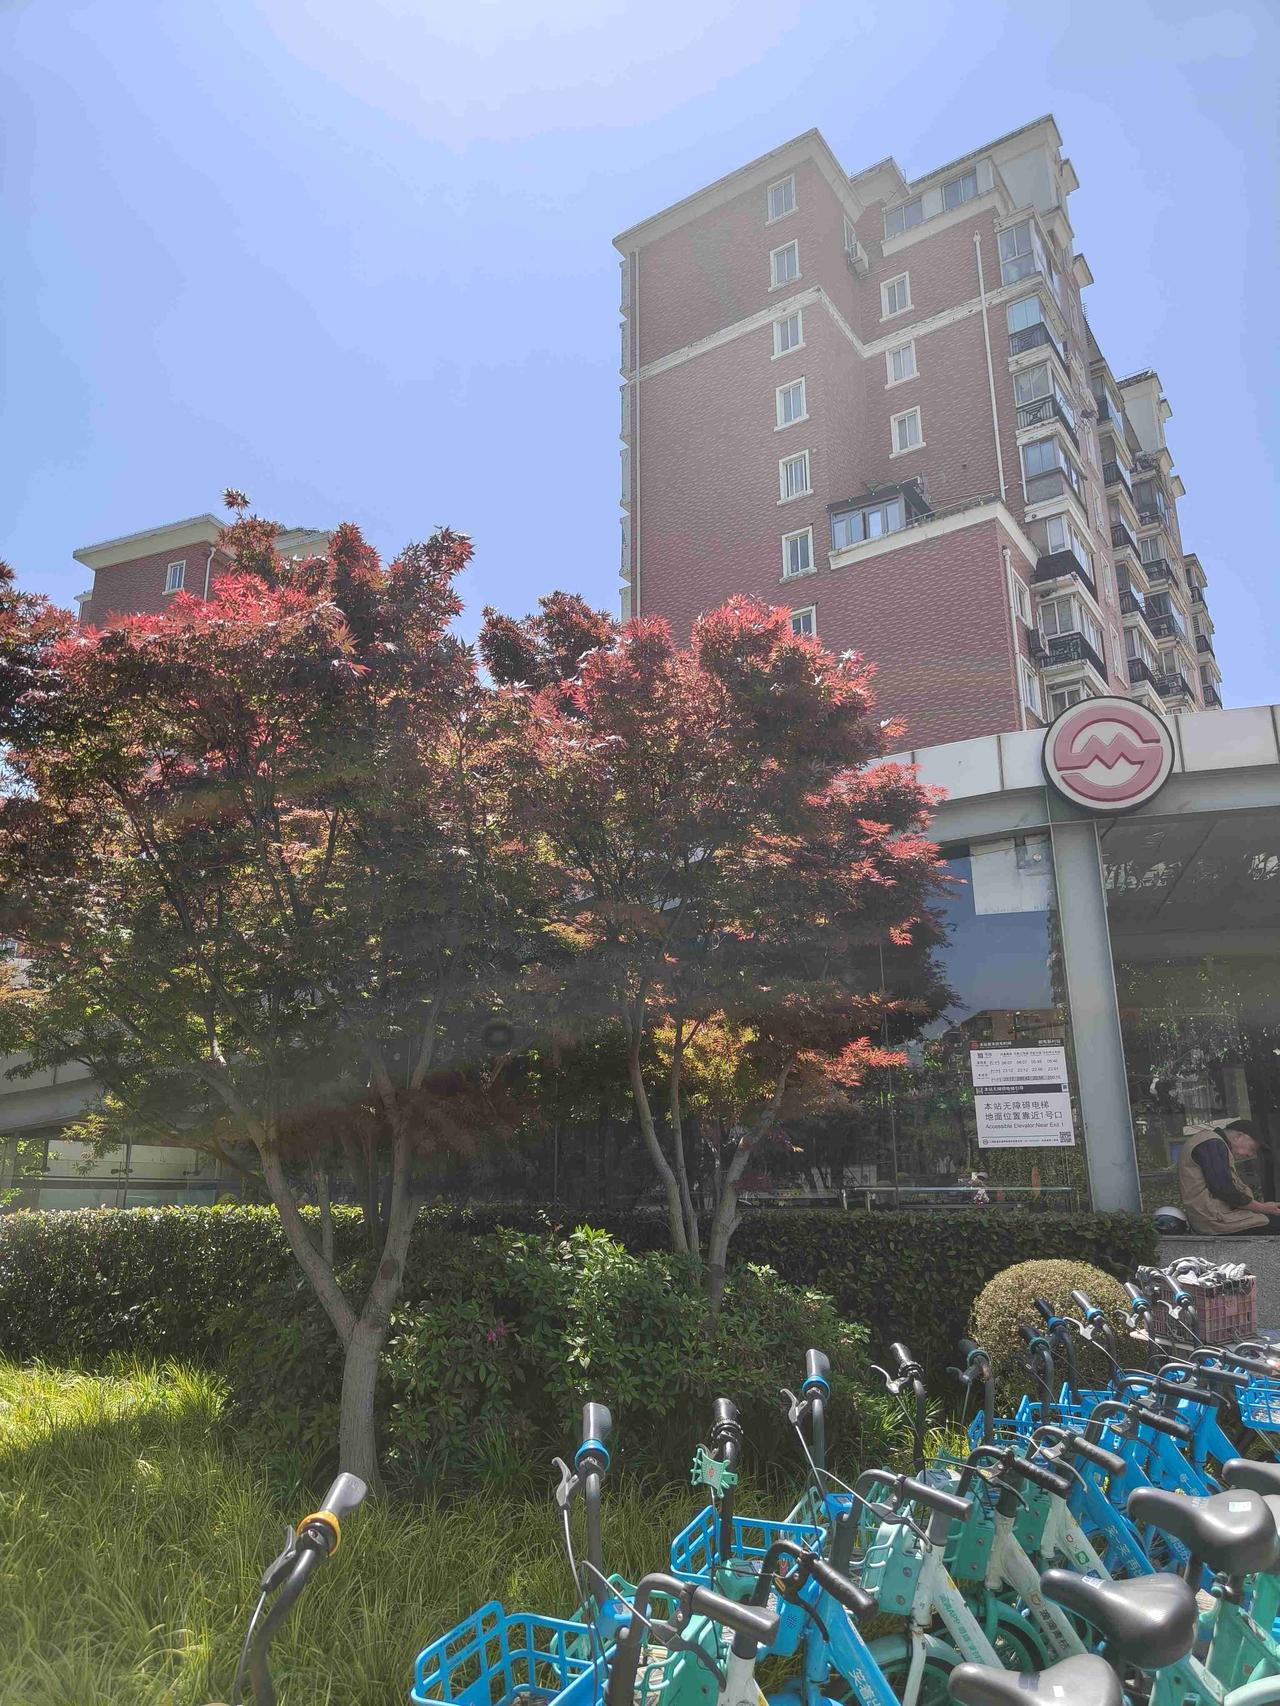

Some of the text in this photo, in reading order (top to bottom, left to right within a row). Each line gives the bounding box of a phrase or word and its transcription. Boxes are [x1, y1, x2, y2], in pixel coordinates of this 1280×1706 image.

[984, 1100, 1050, 1110] 本站无障碍电梯
[985, 1110, 1063, 1121] 地面位置靠近1号口
